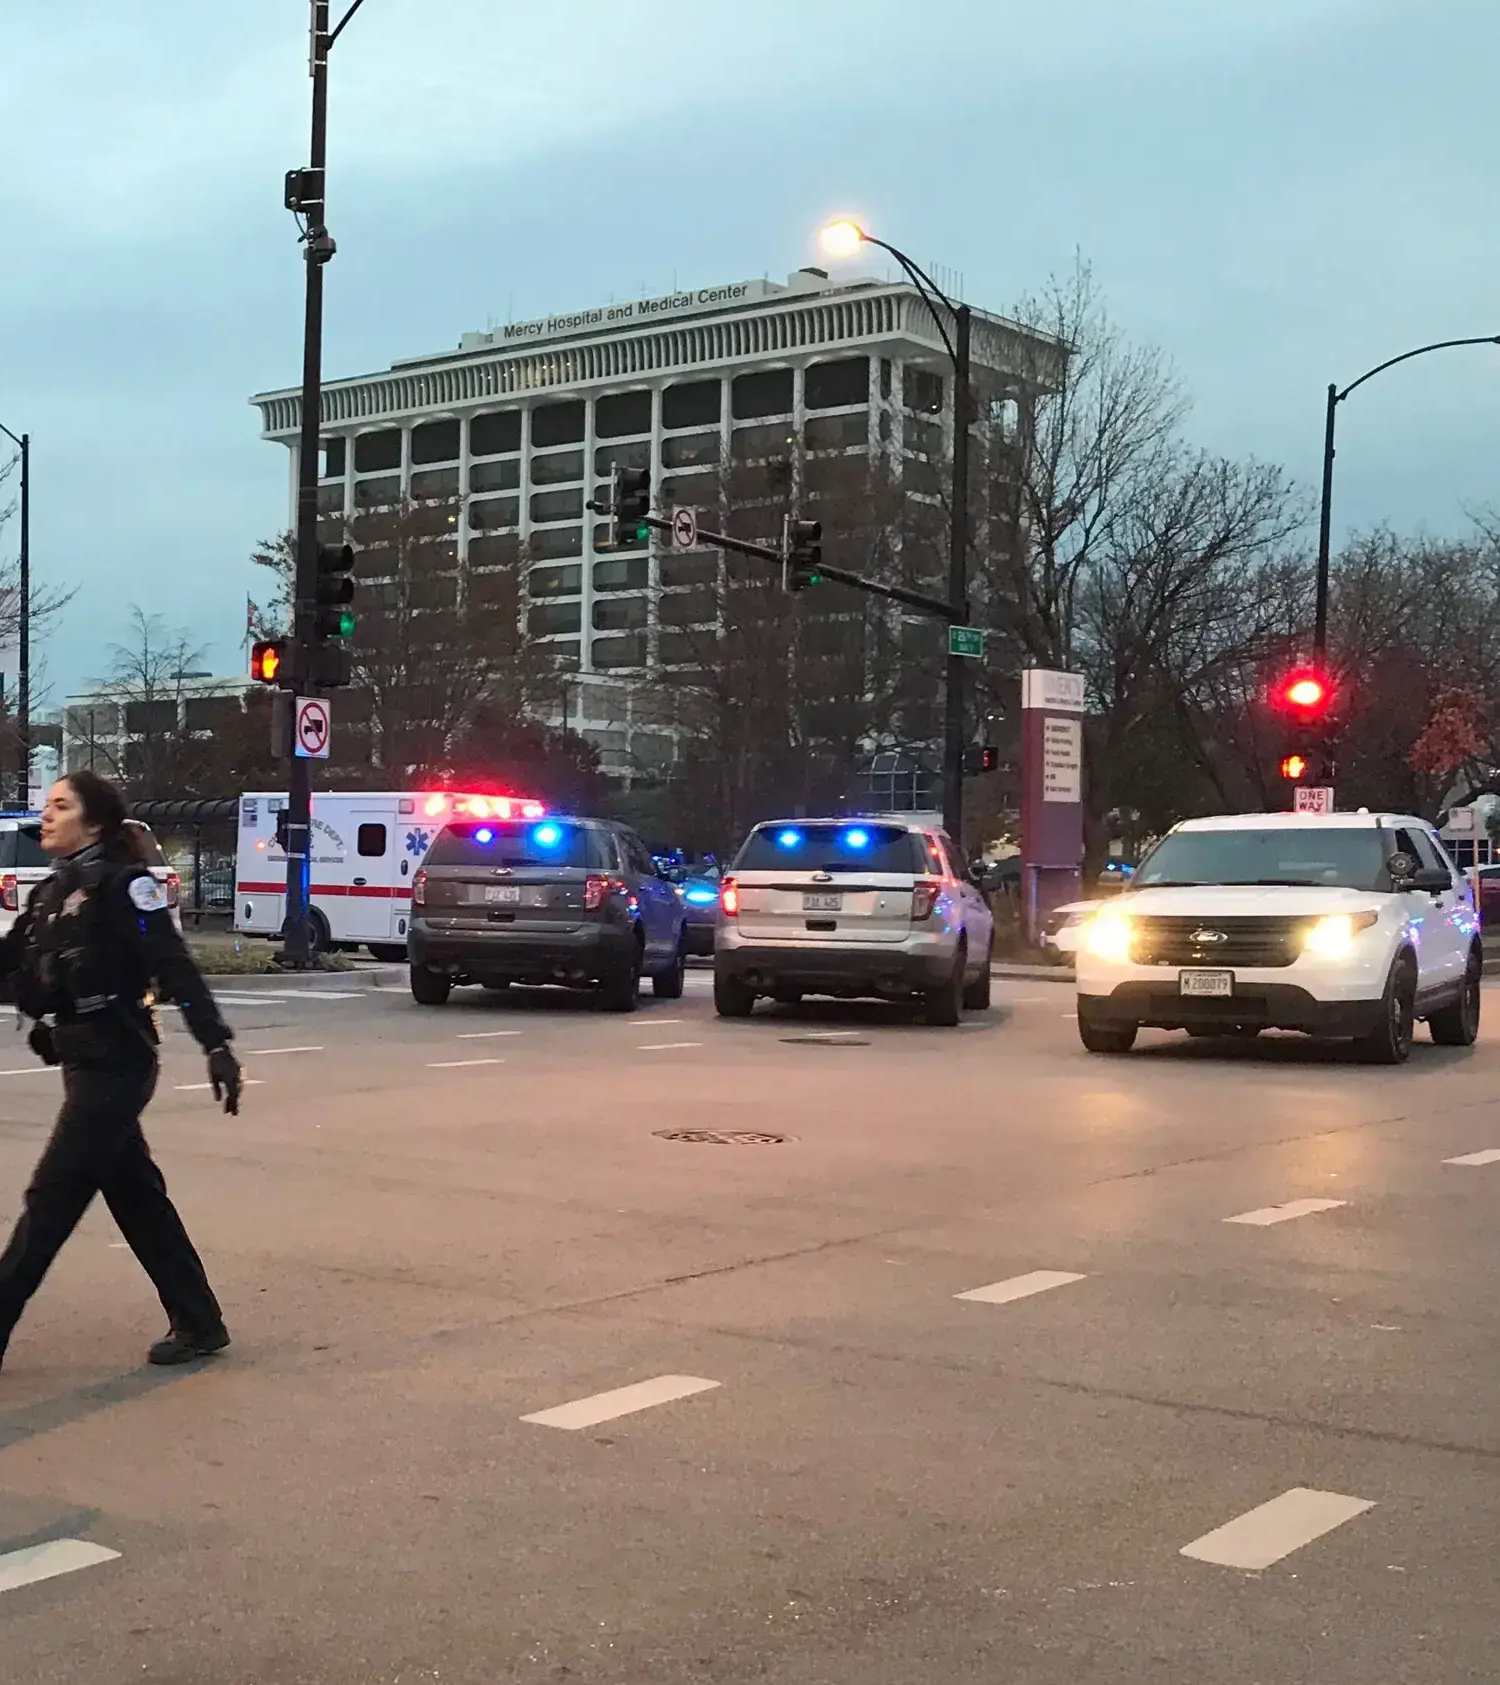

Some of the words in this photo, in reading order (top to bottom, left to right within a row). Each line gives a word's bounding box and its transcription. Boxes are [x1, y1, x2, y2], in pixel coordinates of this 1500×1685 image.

[504, 321, 543, 339] Mercy
[547, 307, 603, 333] Hospital
[607, 304, 633, 320] and
[638, 294, 693, 314] Medical
[698, 284, 748, 304] Center
[1300, 790, 1324, 800] ONE
[1299, 801, 1324, 812] WAY
